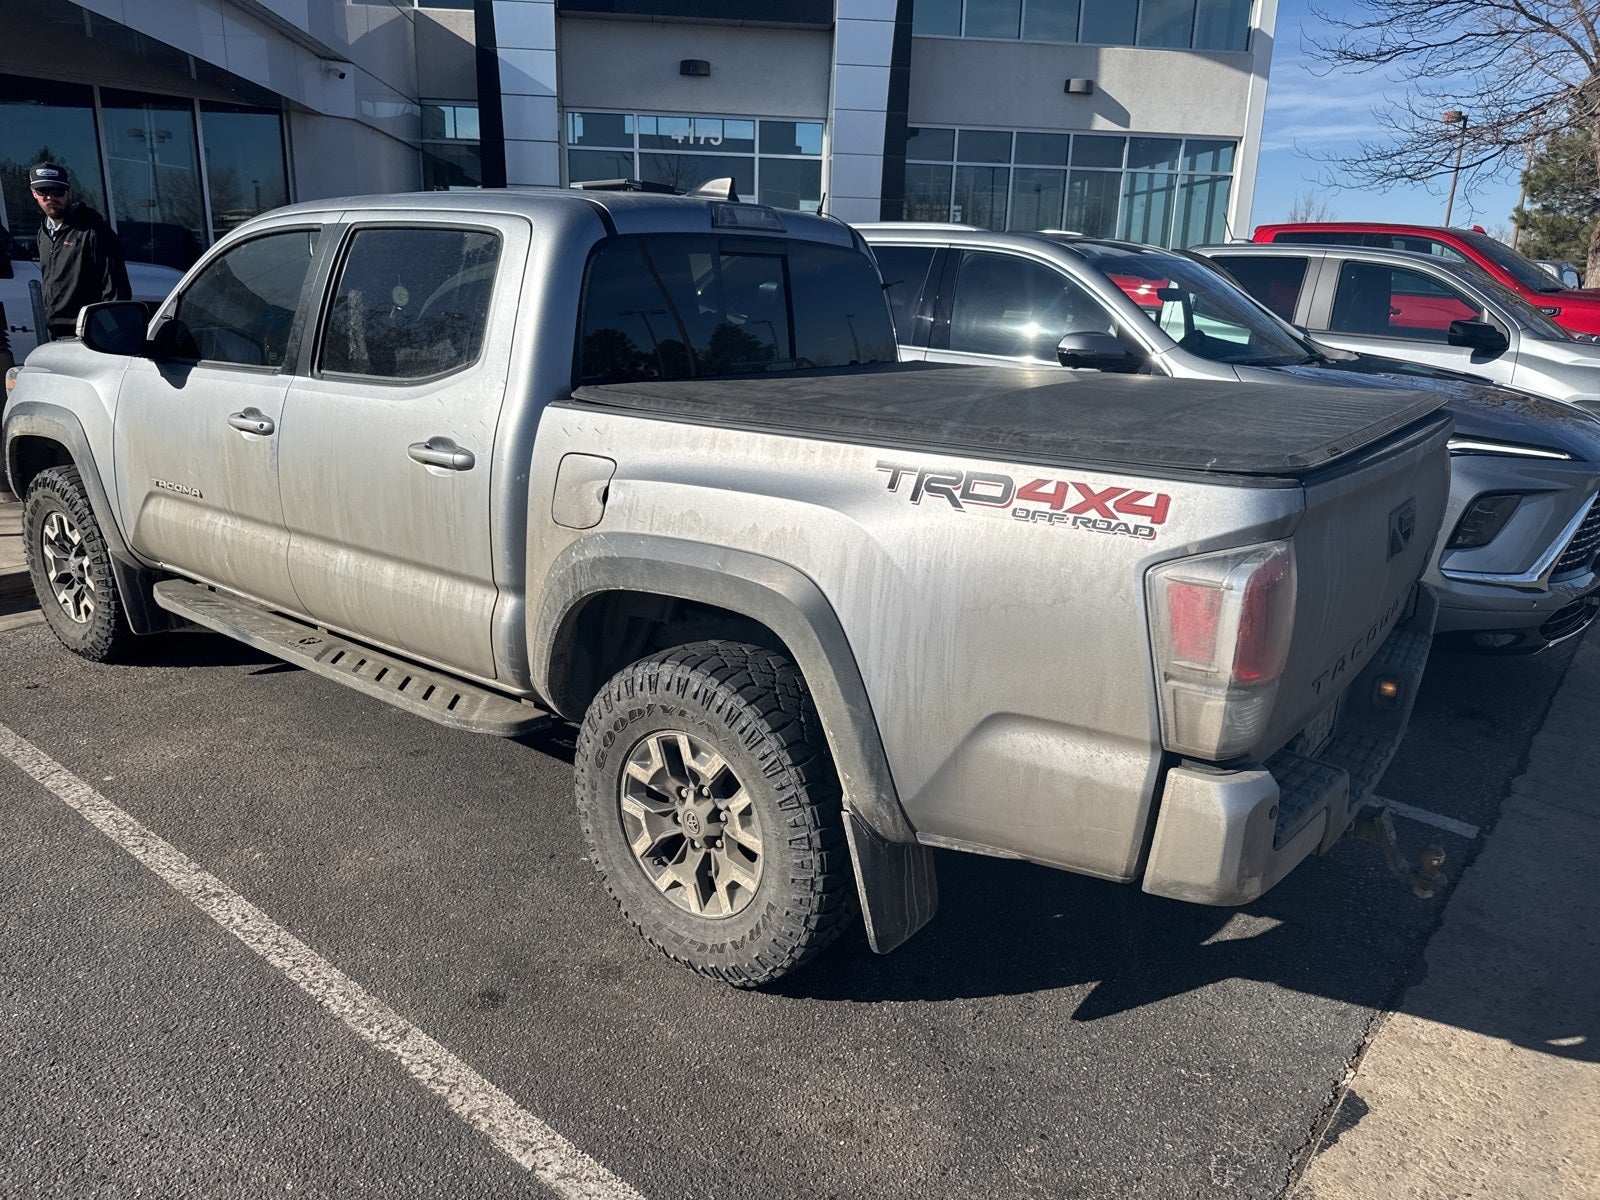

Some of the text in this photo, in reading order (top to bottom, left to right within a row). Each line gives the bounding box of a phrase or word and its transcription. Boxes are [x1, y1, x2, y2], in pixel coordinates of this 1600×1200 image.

[671, 127, 723, 146] 4175
[151, 477, 203, 499] TACOMA
[875, 460, 1017, 513] TRD
[1311, 596, 1400, 695] TACOMA
[593, 702, 740, 770] GOODYEAR
